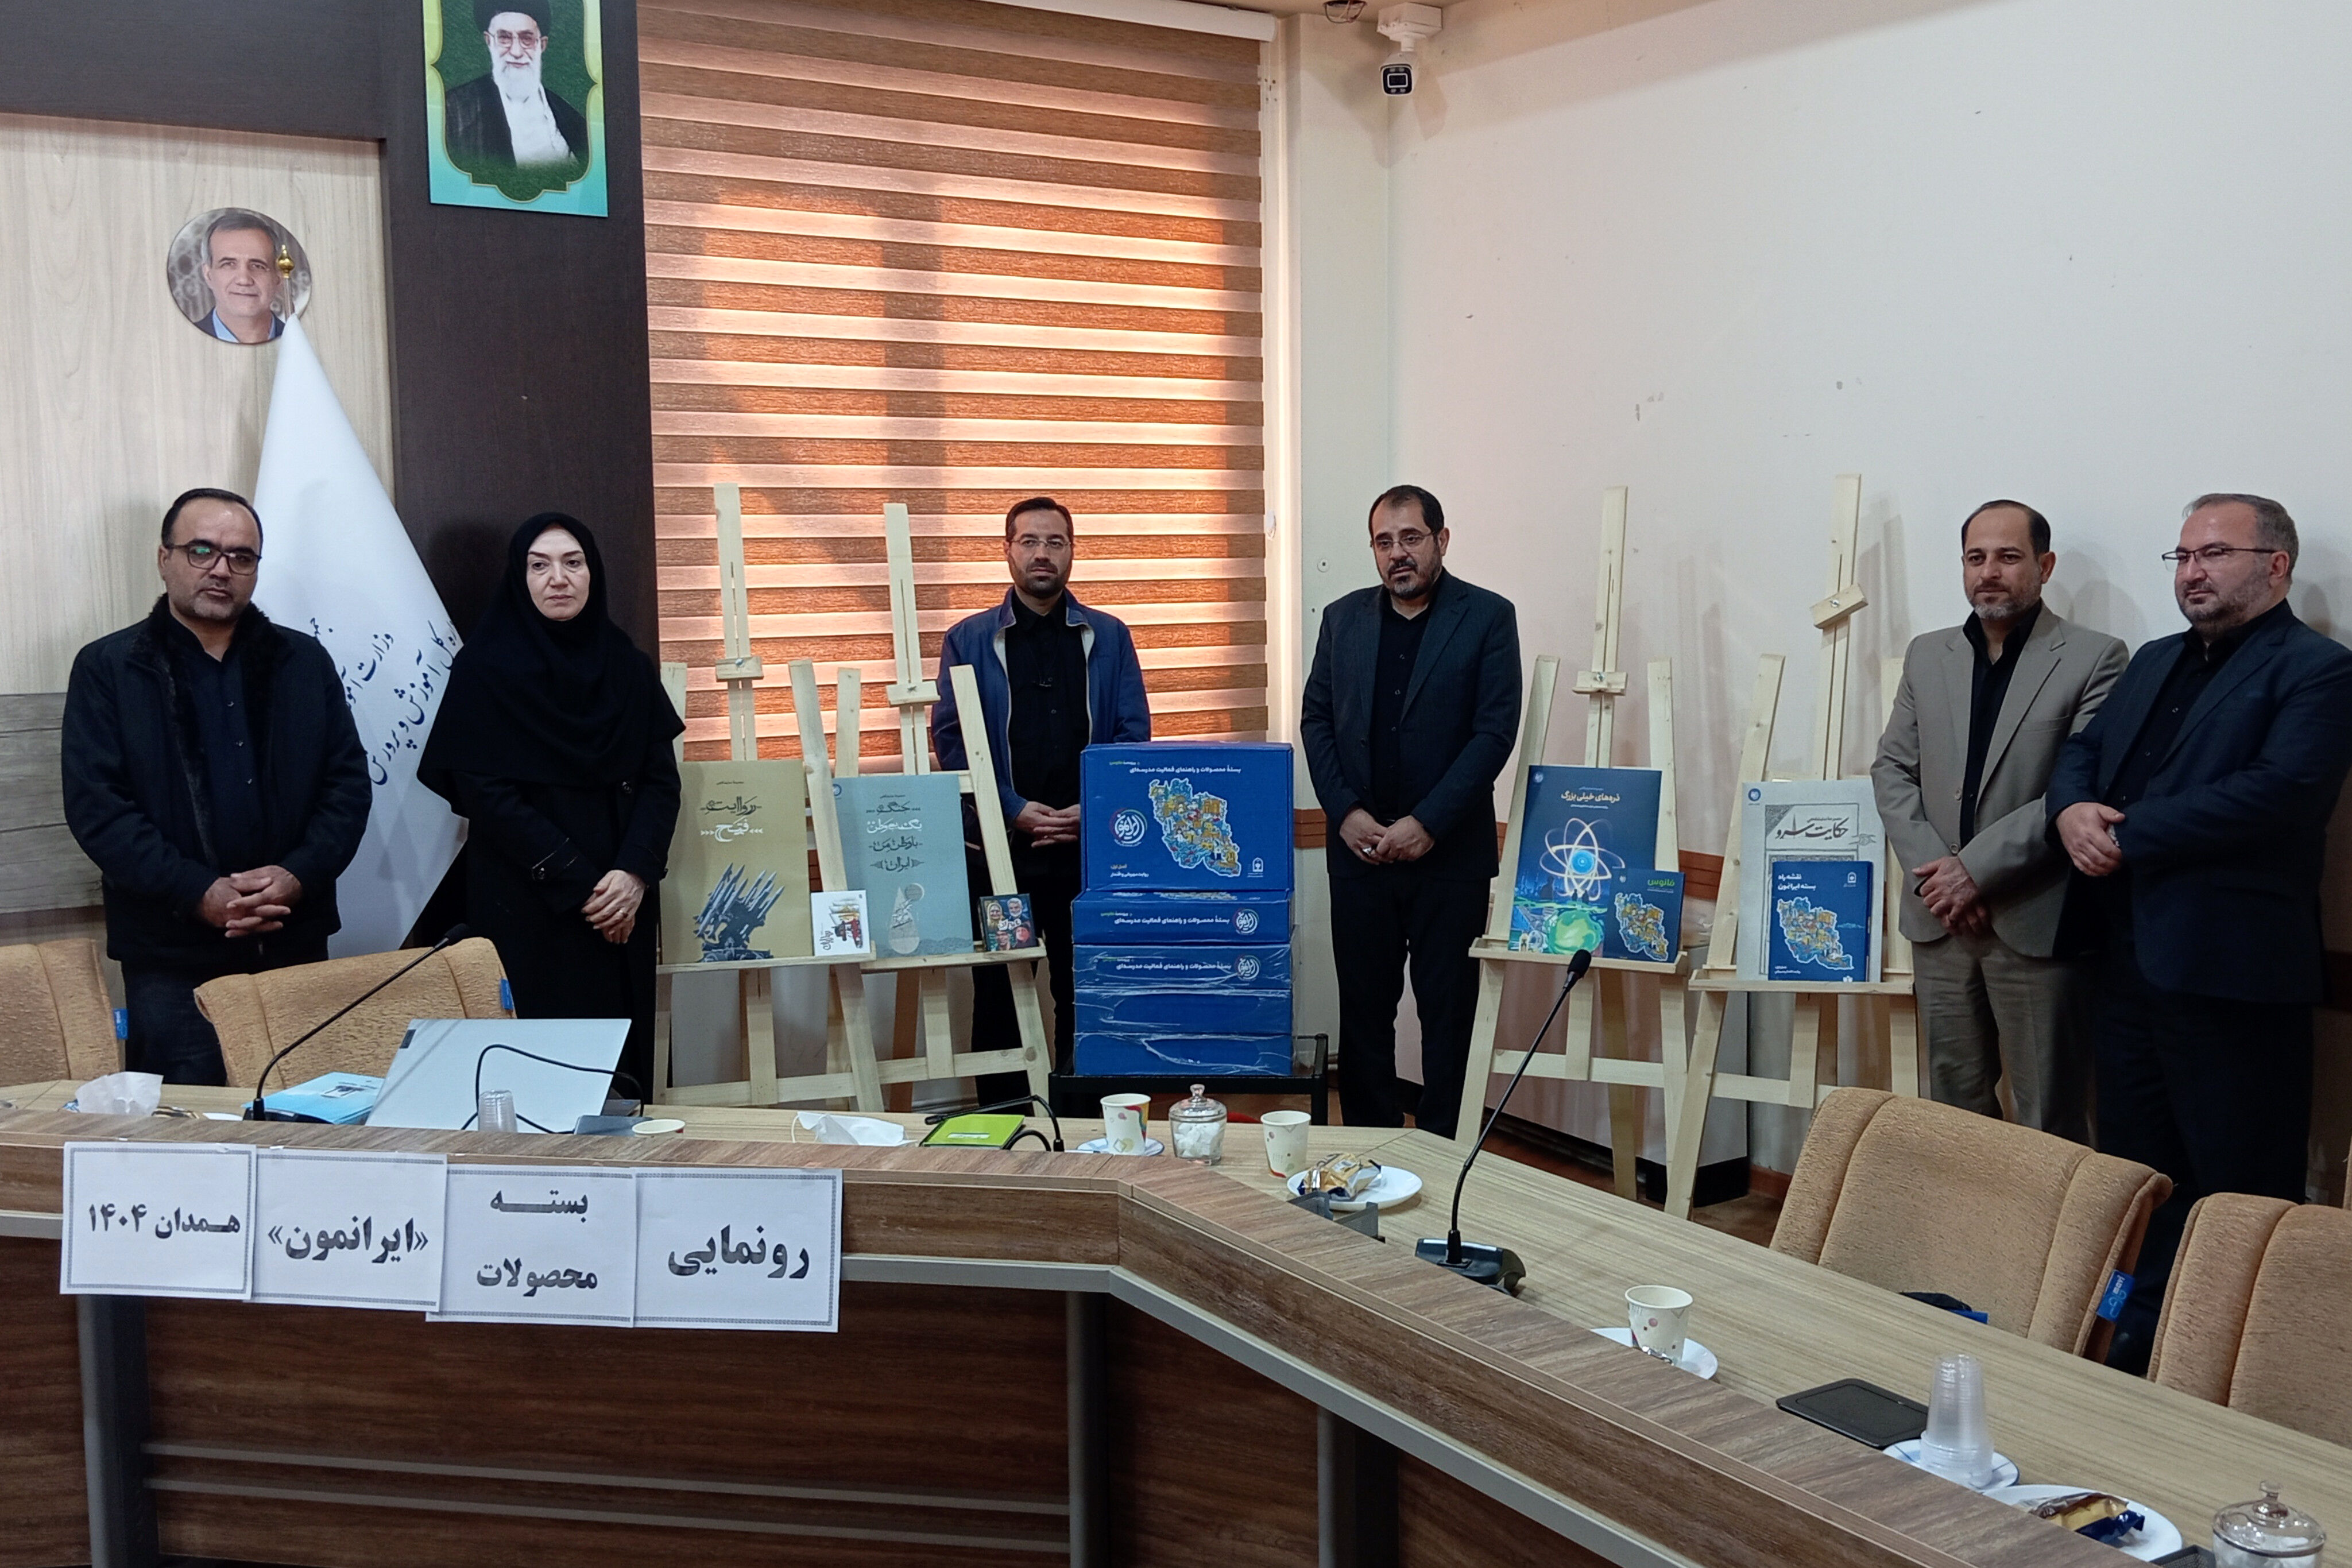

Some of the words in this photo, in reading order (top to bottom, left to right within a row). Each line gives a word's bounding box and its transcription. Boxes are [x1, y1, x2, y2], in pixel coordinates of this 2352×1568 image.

[357, 633, 394, 682] وزارت
[393, 649, 441, 726] آموزش
[399, 721, 409, 733] و
[1561, 790, 1576, 802] بزرگ
[1577, 792, 1594, 802] خیلی
[1775, 823, 1815, 840] سرو
[1806, 817, 1849, 841] حکایت
[1647, 879, 1675, 887] فانوس
[88, 1203, 148, 1233] ۱۴۰۴
[668, 1225, 811, 1279] رونمایی
[476, 1258, 598, 1298] محصولات
